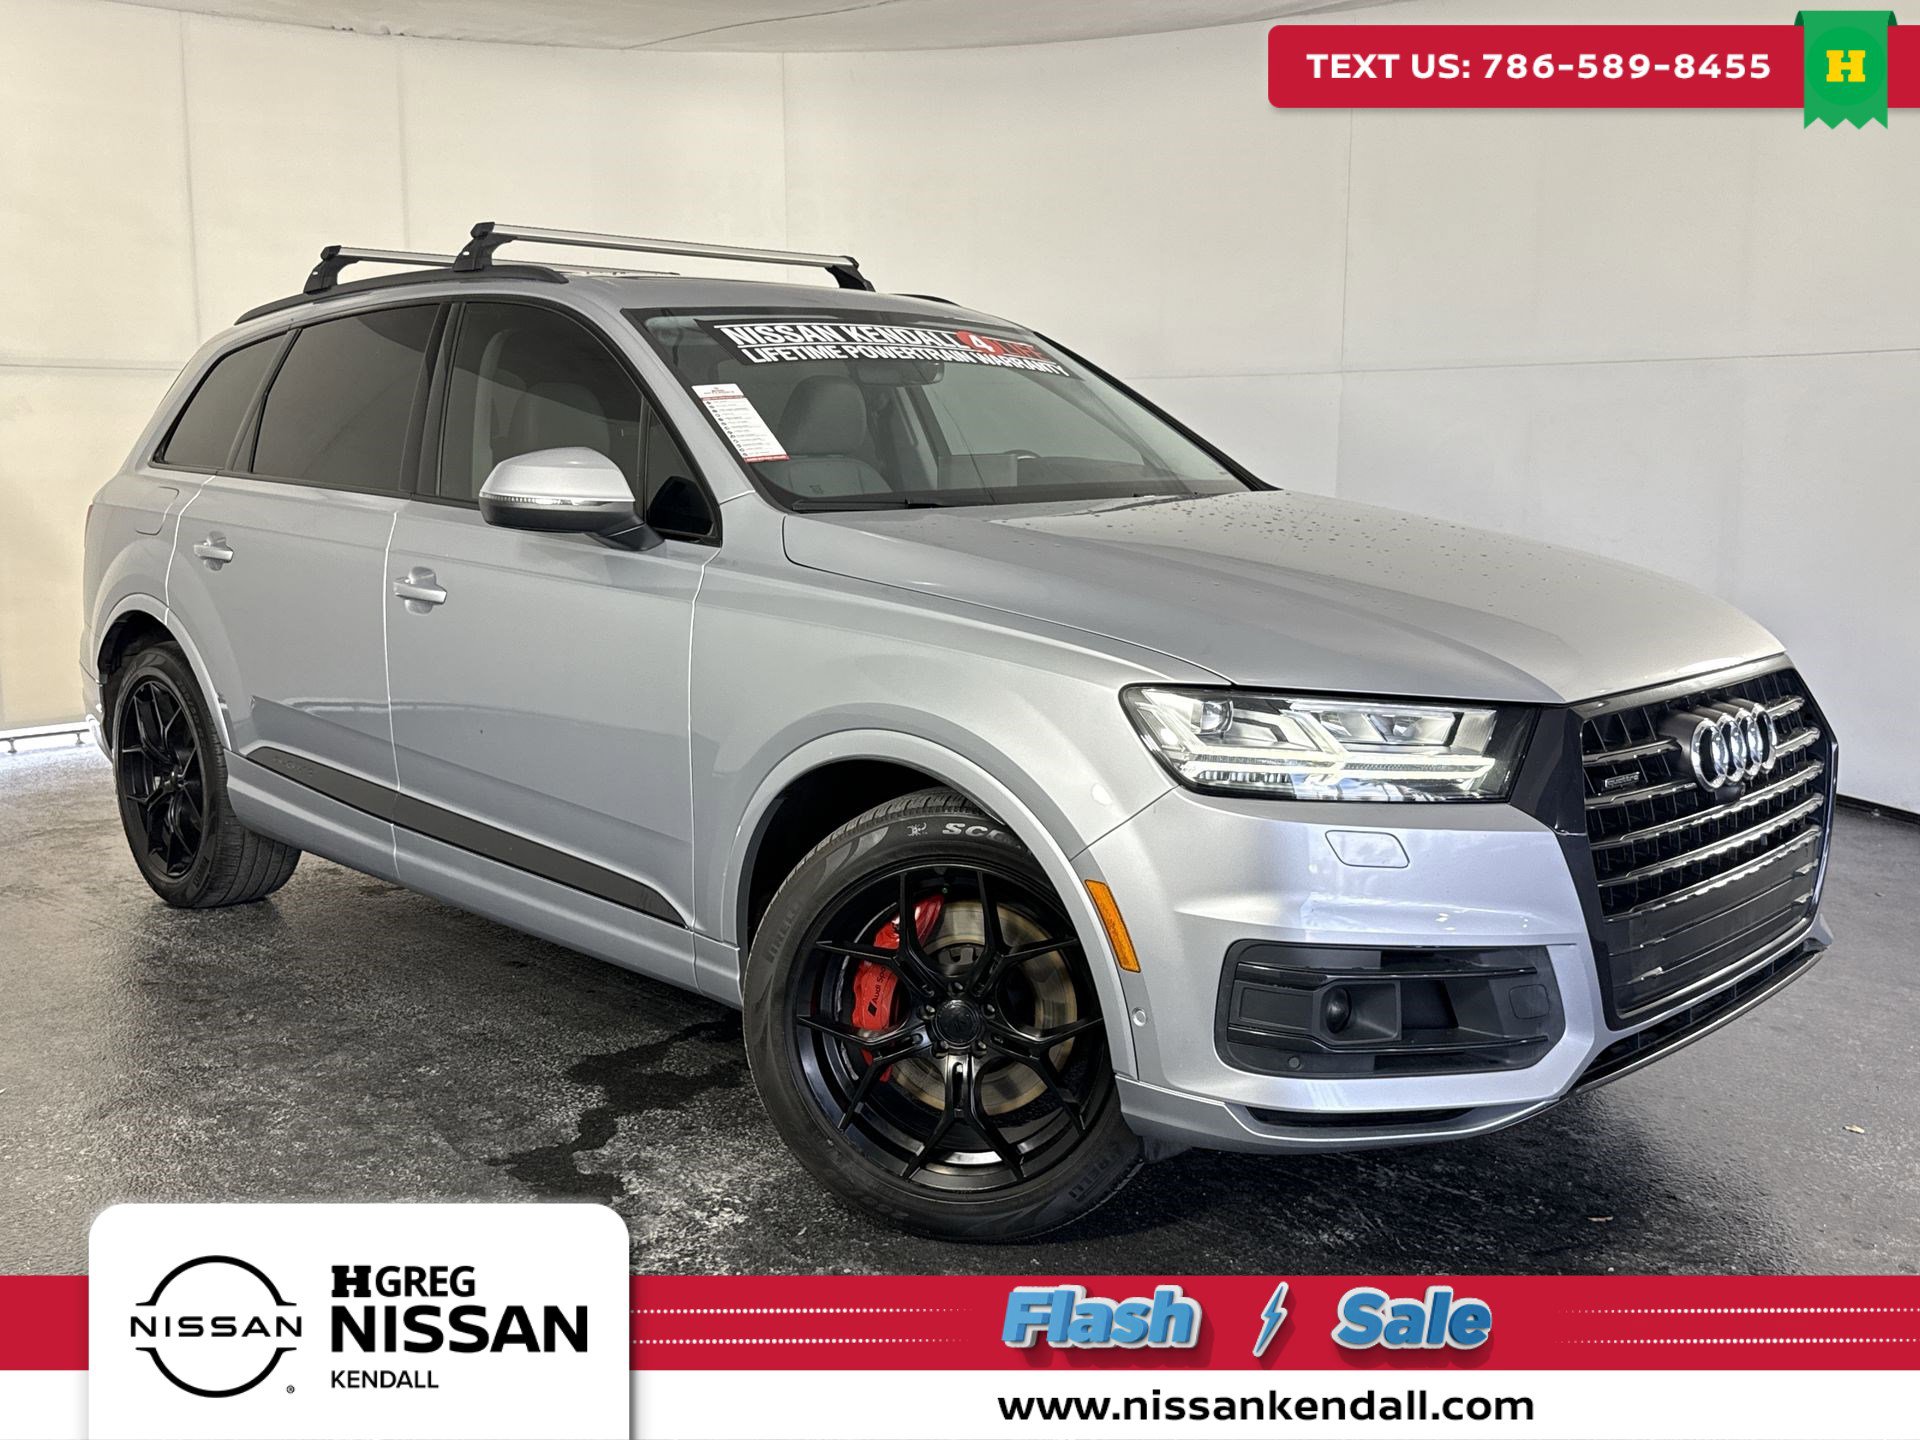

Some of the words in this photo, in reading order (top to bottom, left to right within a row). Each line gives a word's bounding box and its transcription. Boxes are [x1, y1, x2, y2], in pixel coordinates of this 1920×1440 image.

[720, 325, 847, 346] NISSAN
[840, 325, 971, 349] KENDALL
[968, 334, 996, 352] 4
[741, 345, 849, 364] LIFETIME
[845, 345, 977, 364] POWERTRAIN
[975, 351, 1070, 377] WARRANTY
